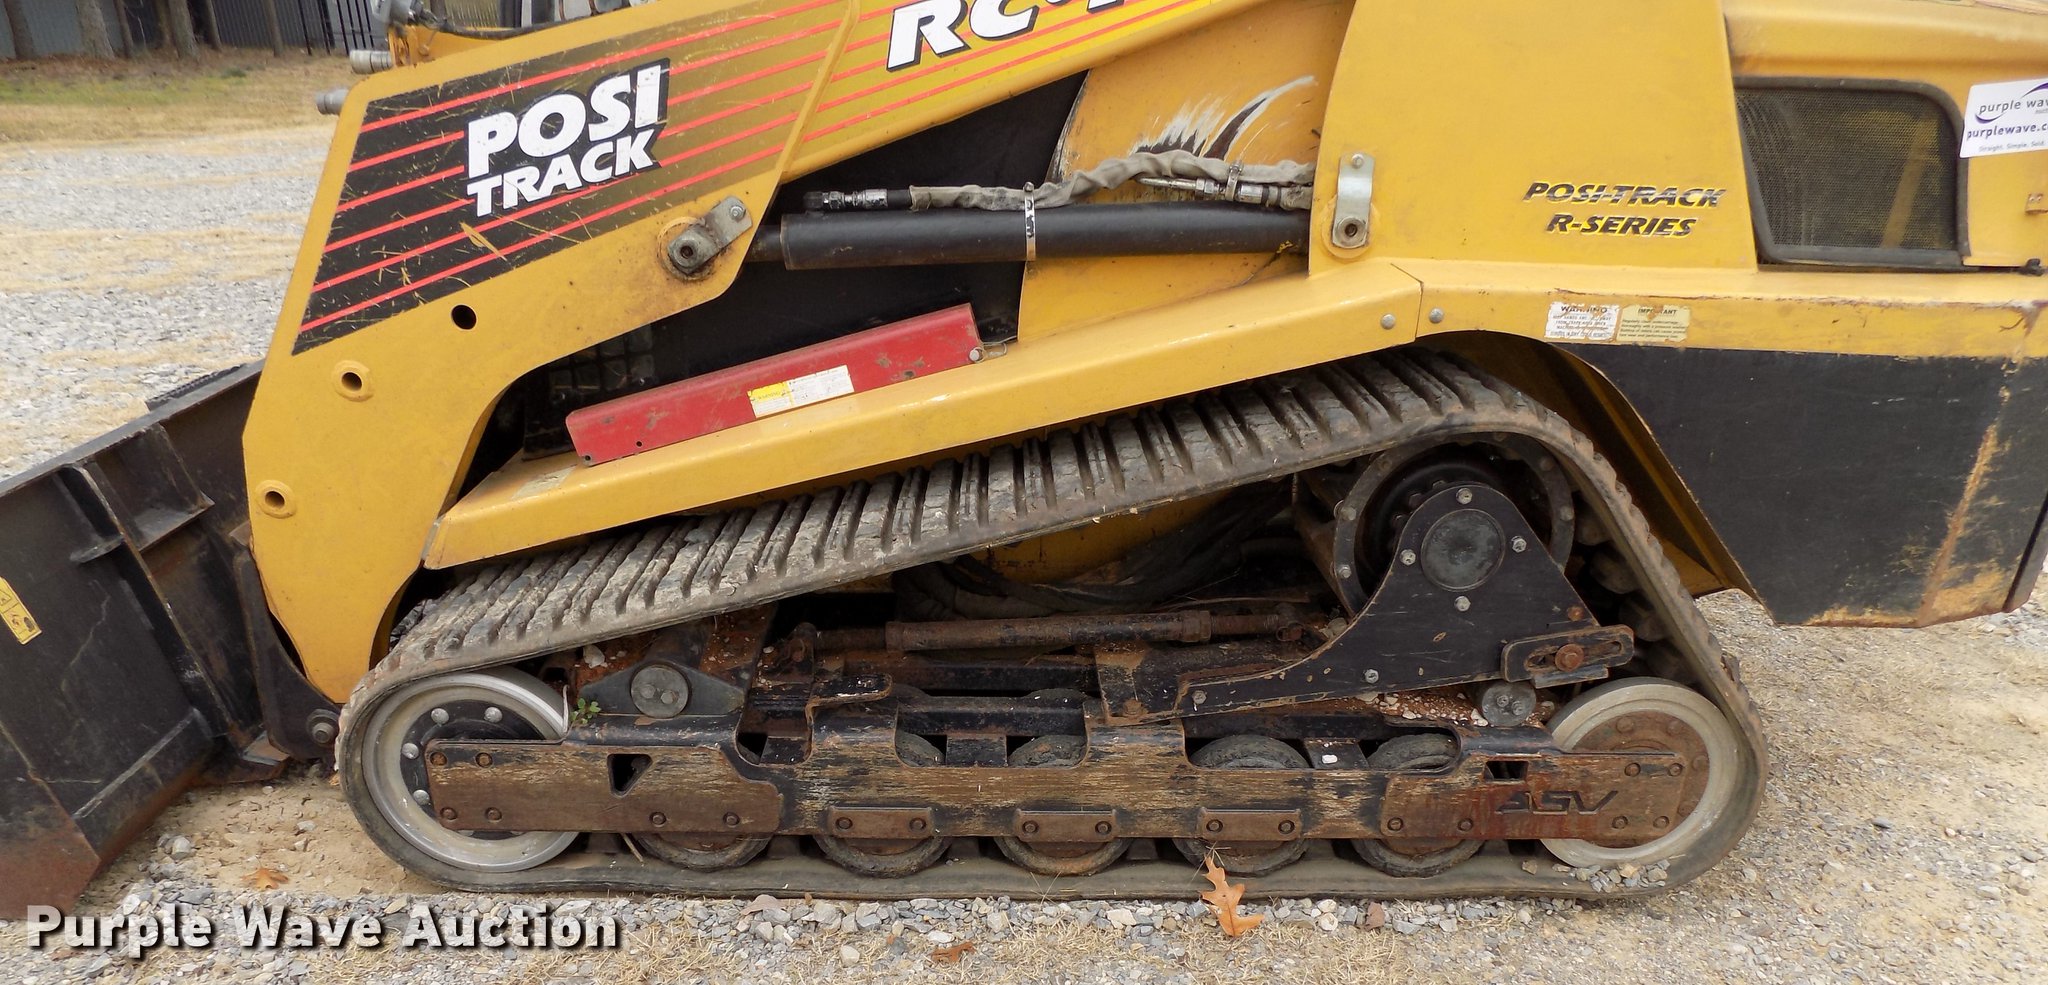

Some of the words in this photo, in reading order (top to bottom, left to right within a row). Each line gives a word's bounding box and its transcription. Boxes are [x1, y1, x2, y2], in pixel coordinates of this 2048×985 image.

[1978, 100, 2021, 115] purple
[468, 64, 662, 178] POSI
[1966, 123, 2048, 141] purplewave.c
[466, 128, 655, 217] TRACK
[1522, 182, 1727, 207] POSI-TRACK
[1546, 213, 1697, 237] R-SERIES
[1495, 790, 1619, 814] ASV
